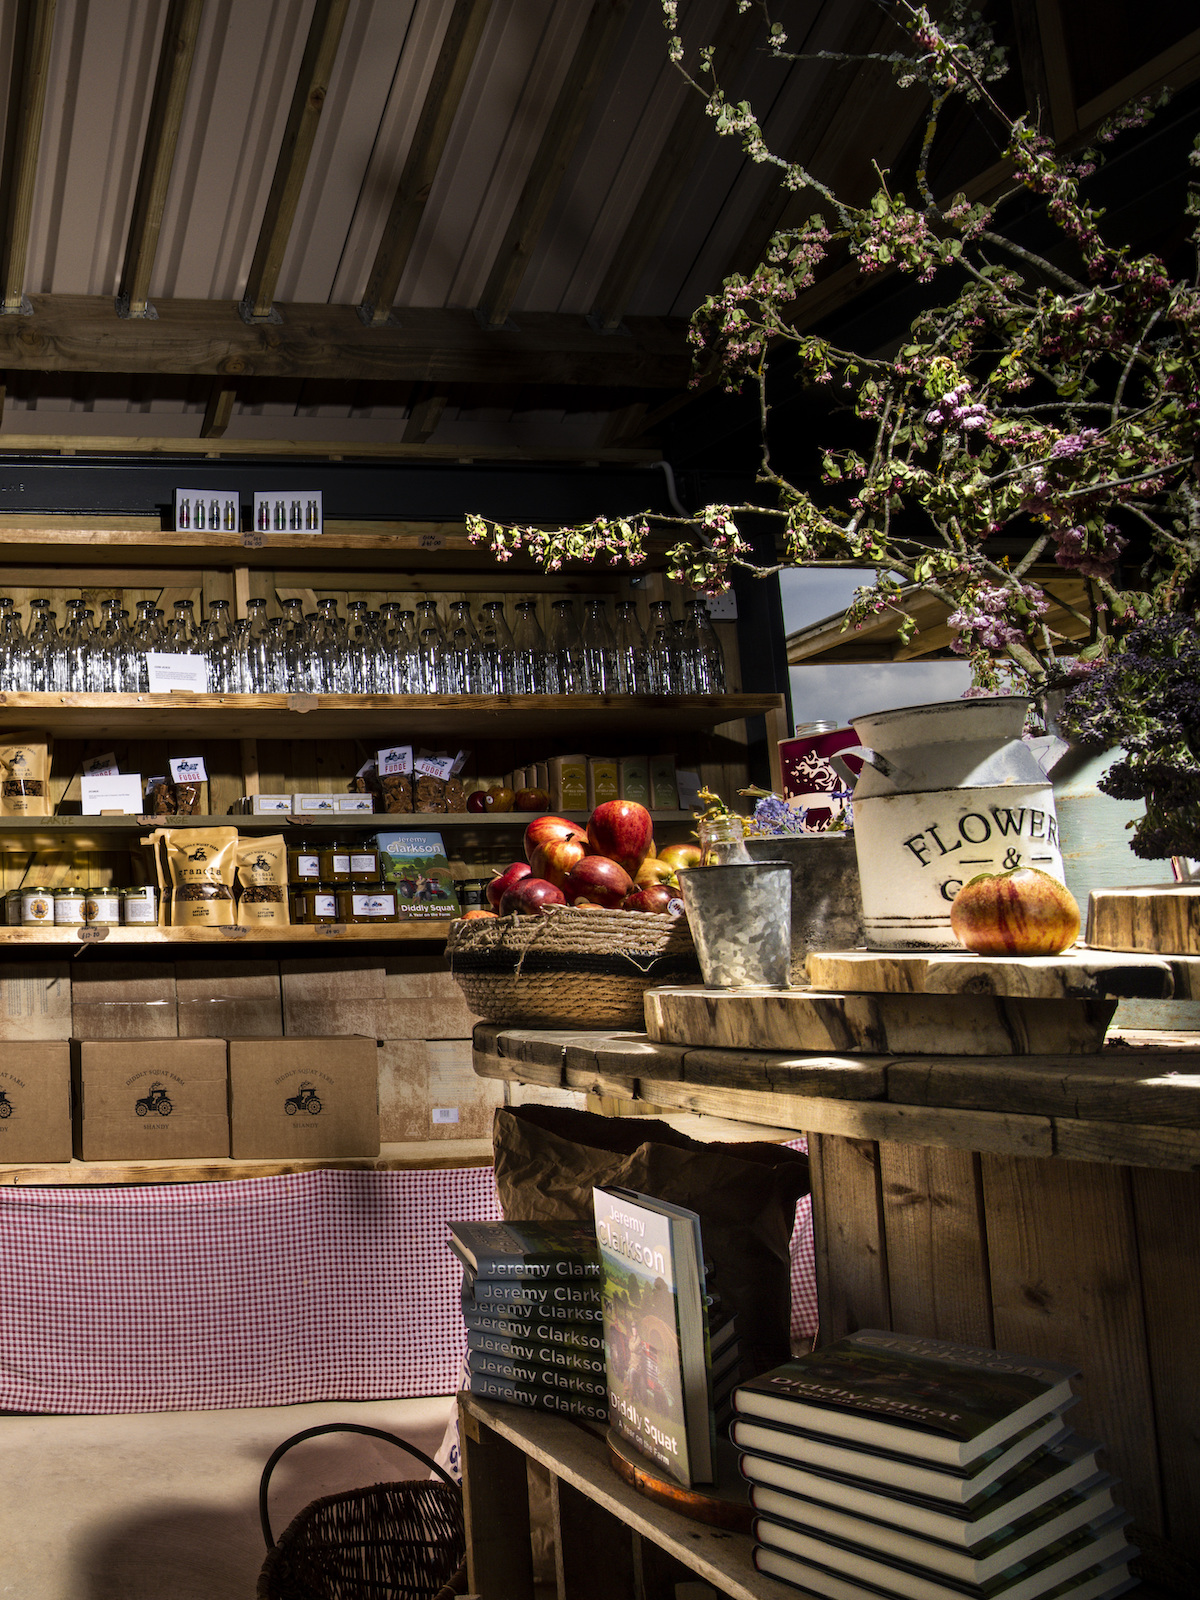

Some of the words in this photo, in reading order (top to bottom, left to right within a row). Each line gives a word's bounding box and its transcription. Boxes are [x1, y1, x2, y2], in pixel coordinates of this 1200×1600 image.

[385, 763, 406, 773] FUDGE
[421, 764, 443, 777] FUDGE
[40, 816, 74, 824] LARGE
[387, 844, 440, 853] Clarkson
[1002, 847, 1022, 870] &
[10, 1074, 26, 1088] FARM
[126, 1071, 147, 1086] DIDDLY
[170, 1072, 185, 1086] FARM
[275, 1070, 296, 1085] DIDDLY
[319, 1071, 334, 1085] FARM
[609, 1205, 645, 1237] Jeremy
[598, 1220, 665, 1274] Clarkson
[488, 1262, 550, 1278] Jeremy
[556, 1262, 600, 1276] Clark
[484, 1285, 548, 1302] Jeremy
[554, 1287, 600, 1302] Clark
[470, 1302, 532, 1317] Jeremy
[474, 1317, 531, 1337] Jeremy
[477, 1336, 534, 1359] Jeremy
[855, 1336, 1044, 1378] Clarkson
[479, 1359, 537, 1383] Jeremy
[480, 1381, 537, 1406] Jeremy
[543, 1395, 610, 1420] Clarkso
[770, 1376, 864, 1400] Diddly
[870, 1396, 962, 1422] Squat
[886, 1406, 927, 1420] Farm
[610, 1392, 642, 1430] Diddly
[644, 1417, 678, 1455] Squat
[624, 1424, 635, 1438] Year
[636, 1434, 642, 1445] on
[644, 1440, 652, 1453] the
[654, 1448, 670, 1465] Farm
